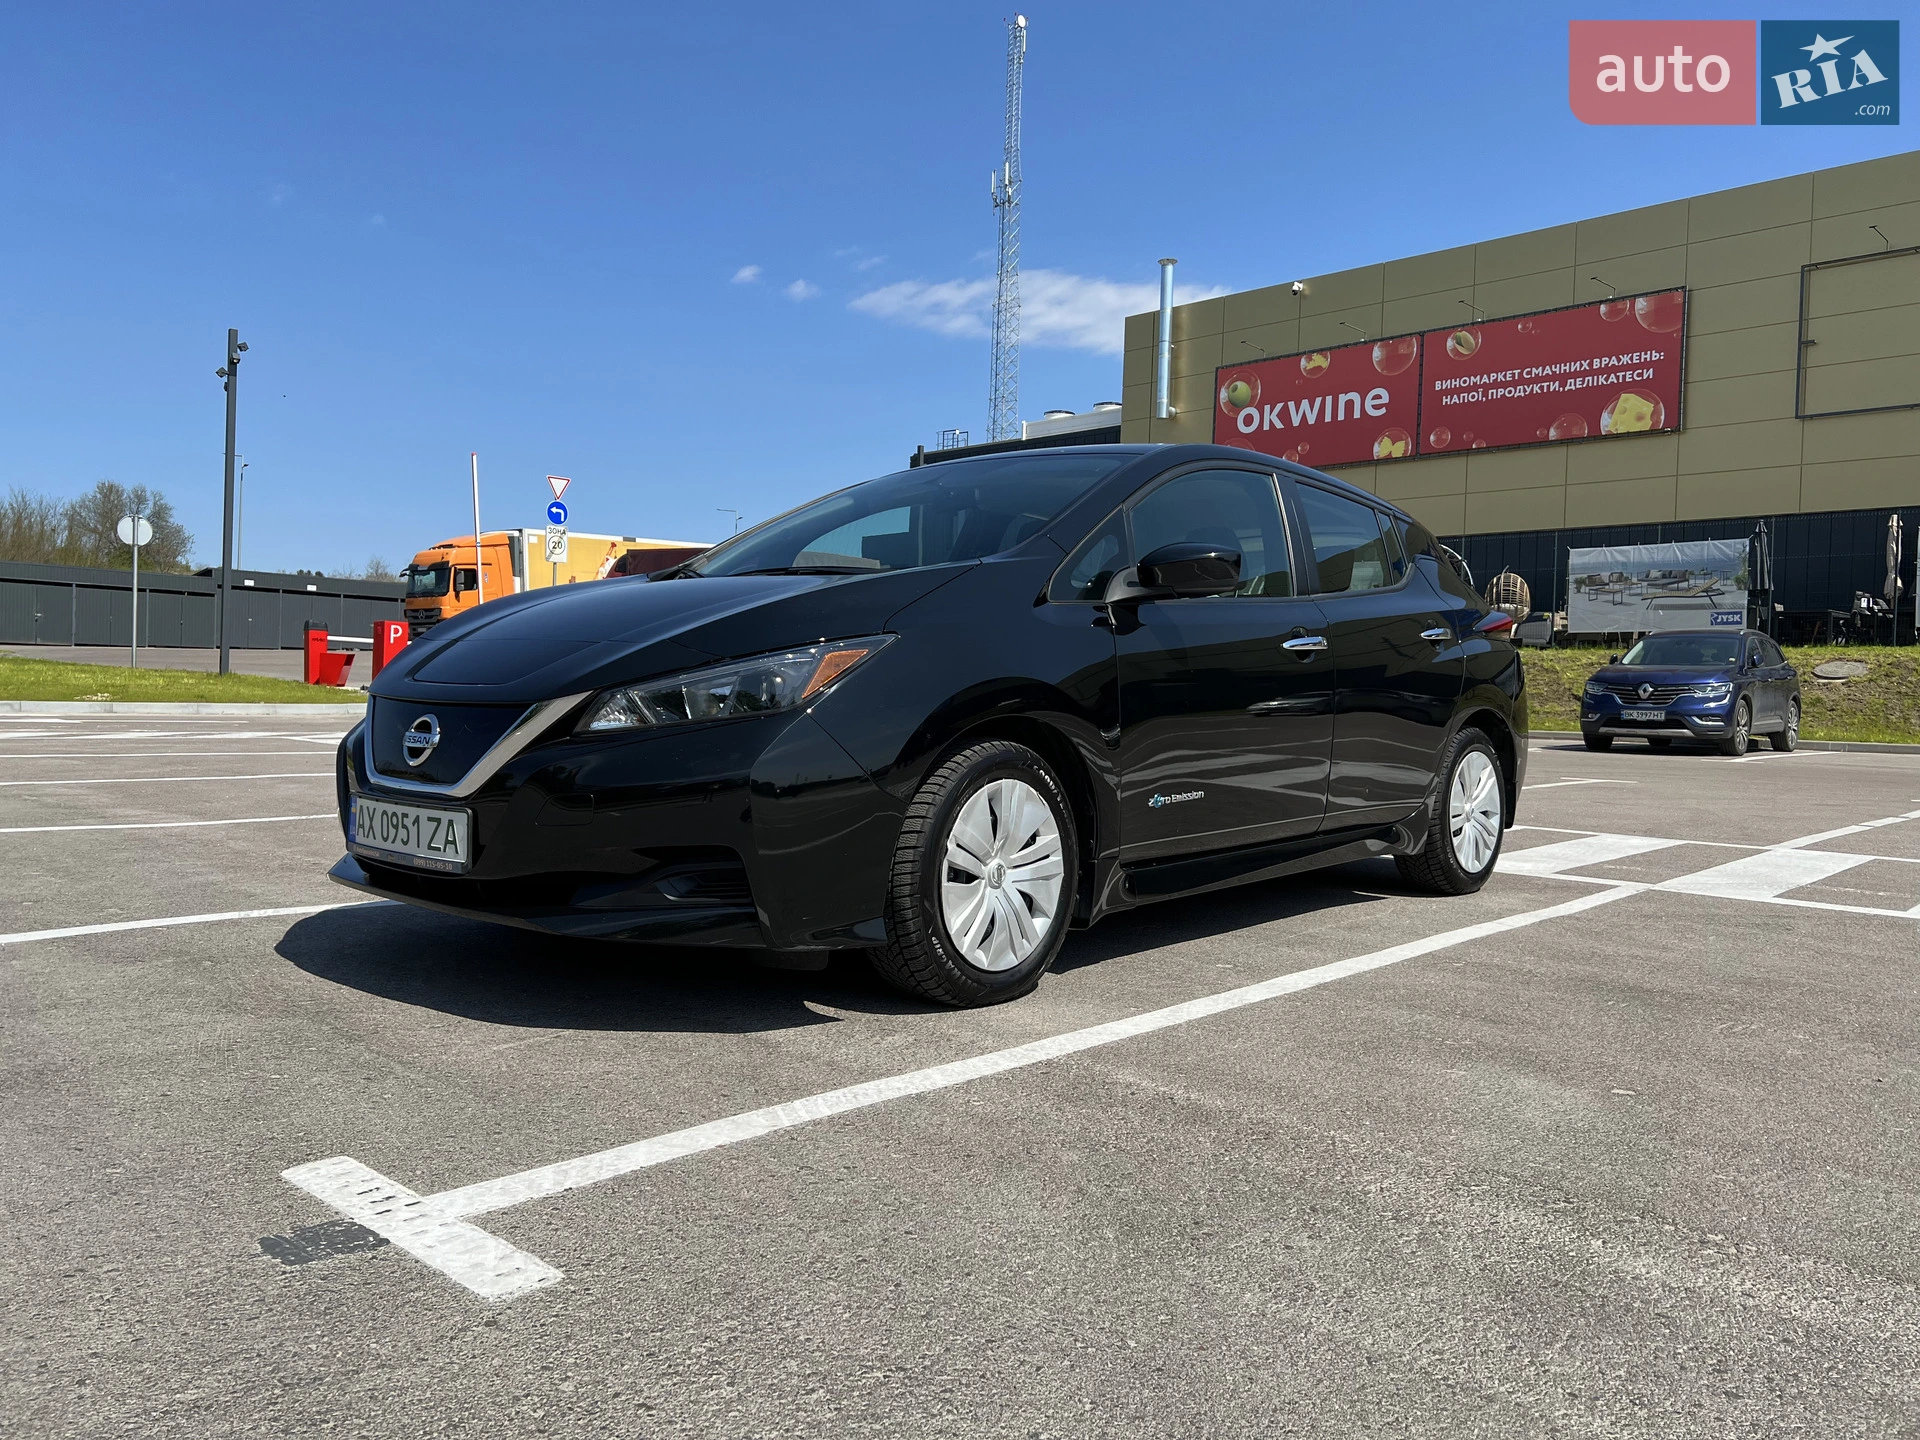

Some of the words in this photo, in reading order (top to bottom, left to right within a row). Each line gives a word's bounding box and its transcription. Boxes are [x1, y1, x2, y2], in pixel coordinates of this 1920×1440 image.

[1435, 369, 1521, 391] ВИНОМАРКЕТ
[1523, 359, 1590, 379] СМАЧНИХ
[1592, 350, 1665, 369] ВРАЖЕНЬ:
[1442, 389, 1486, 406] НАПОЇ,
[1488, 381, 1563, 400] ПРОДУКТИ,
[1565, 368, 1654, 391] ДЕЛІКАТЕСИ
[548, 527, 566, 535] ЗОНА
[551, 541, 563, 550] 20
[1716, 614, 1742, 622] JYSK
[390, 624, 403, 644] P
[405, 734, 431, 745] SSAN
[356, 804, 377, 841] AX
[380, 809, 421, 848] 0951
[426, 815, 460, 855] ZA
[931, 936, 947, 963] GRIP
